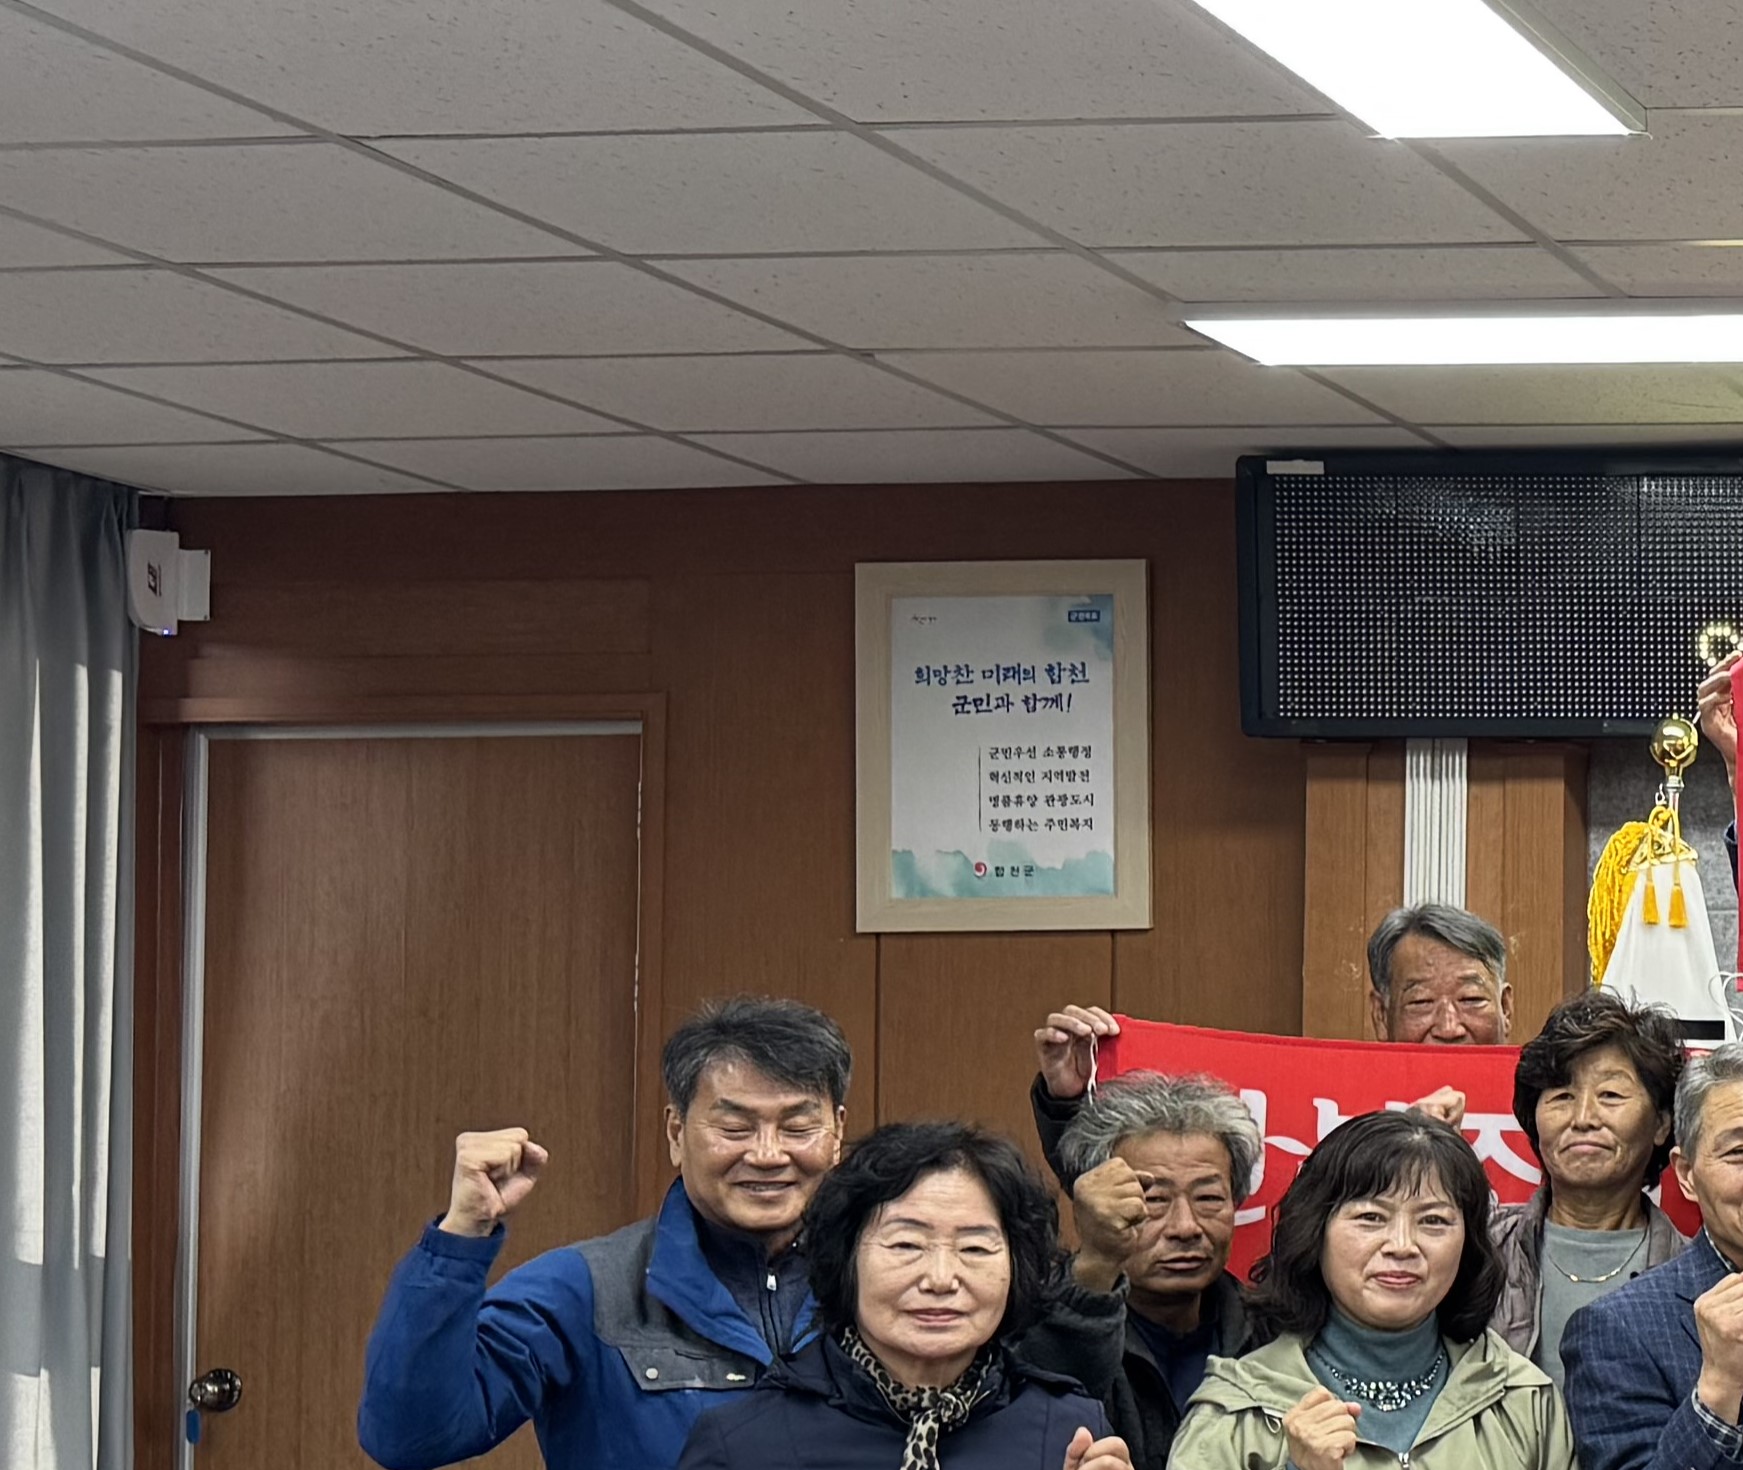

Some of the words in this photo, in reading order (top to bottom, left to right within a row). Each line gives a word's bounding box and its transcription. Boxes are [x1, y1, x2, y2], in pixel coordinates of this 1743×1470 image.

[914, 664, 974, 687] 희망찬
[981, 662, 1036, 686] 미래의
[1044, 661, 1090, 685] 합천
[952, 693, 1015, 716] 군민과
[1021, 692, 1073, 714] 함께!
